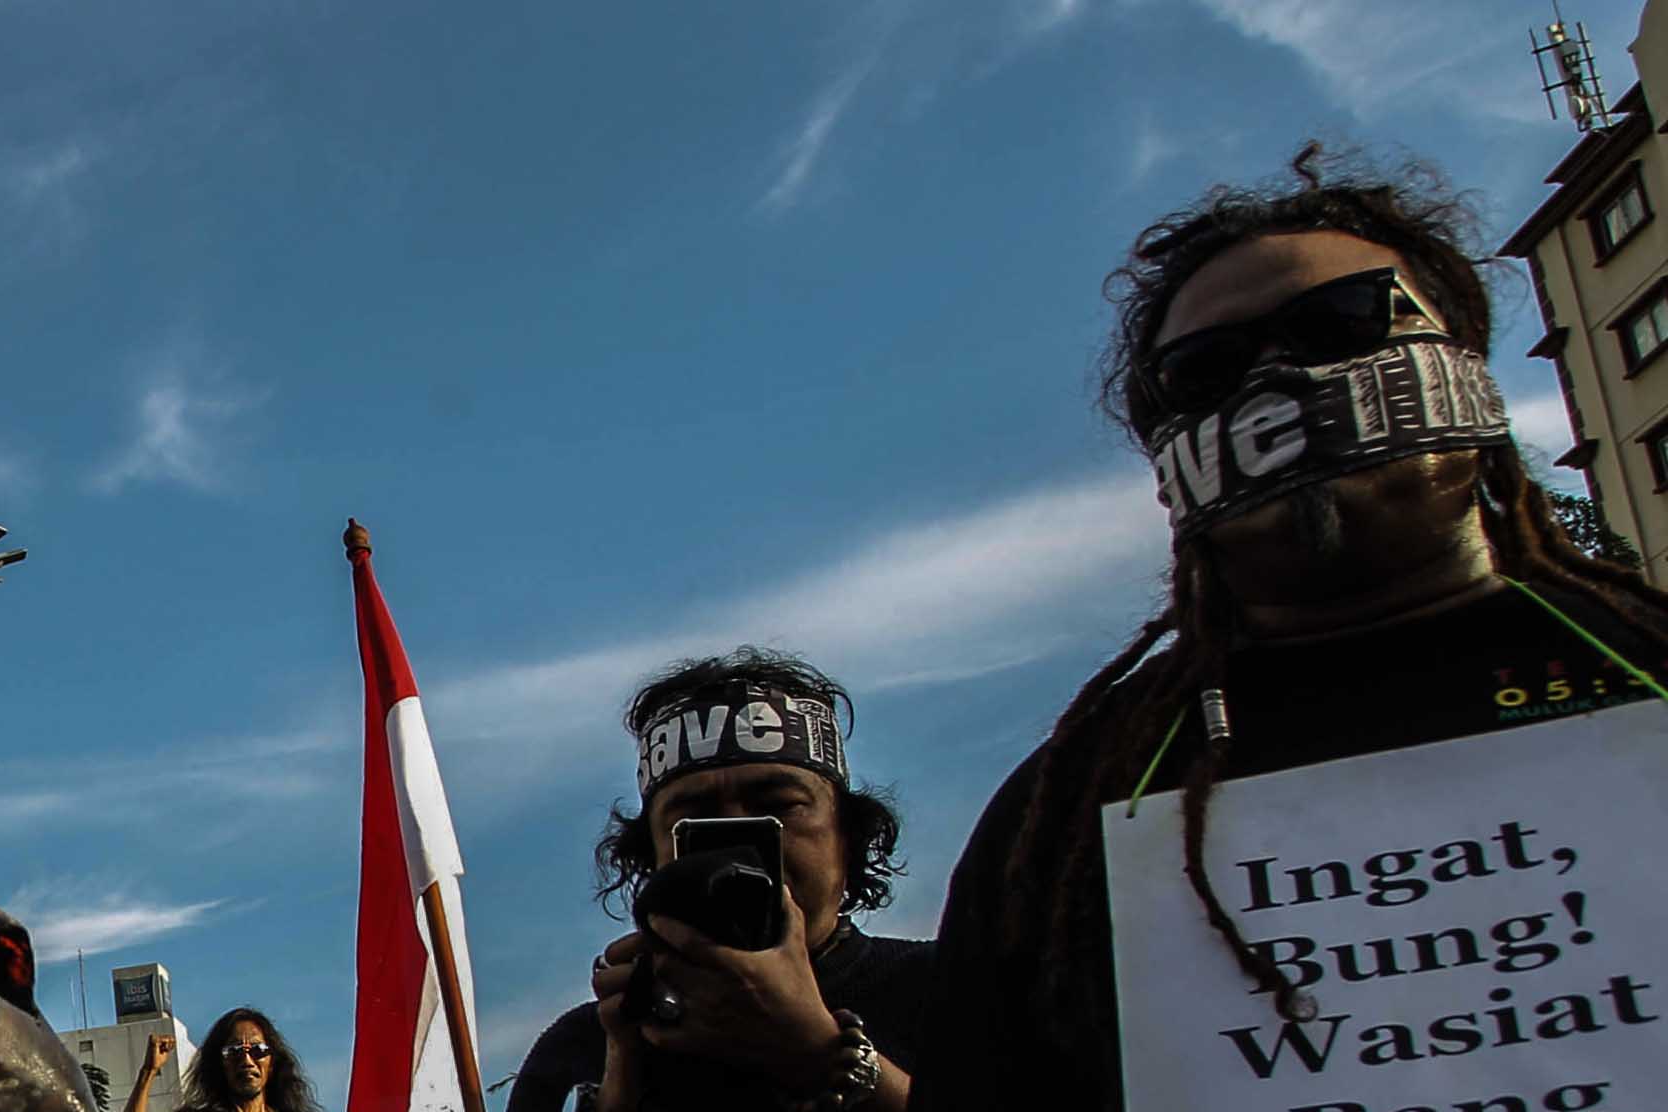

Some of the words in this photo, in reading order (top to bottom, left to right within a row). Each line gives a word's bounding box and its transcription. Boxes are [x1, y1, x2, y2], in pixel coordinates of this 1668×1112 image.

[1235, 821, 1578, 912] Ingat,
[1249, 891, 1596, 994] Bung!
[1219, 974, 1659, 1079] Wasiat
